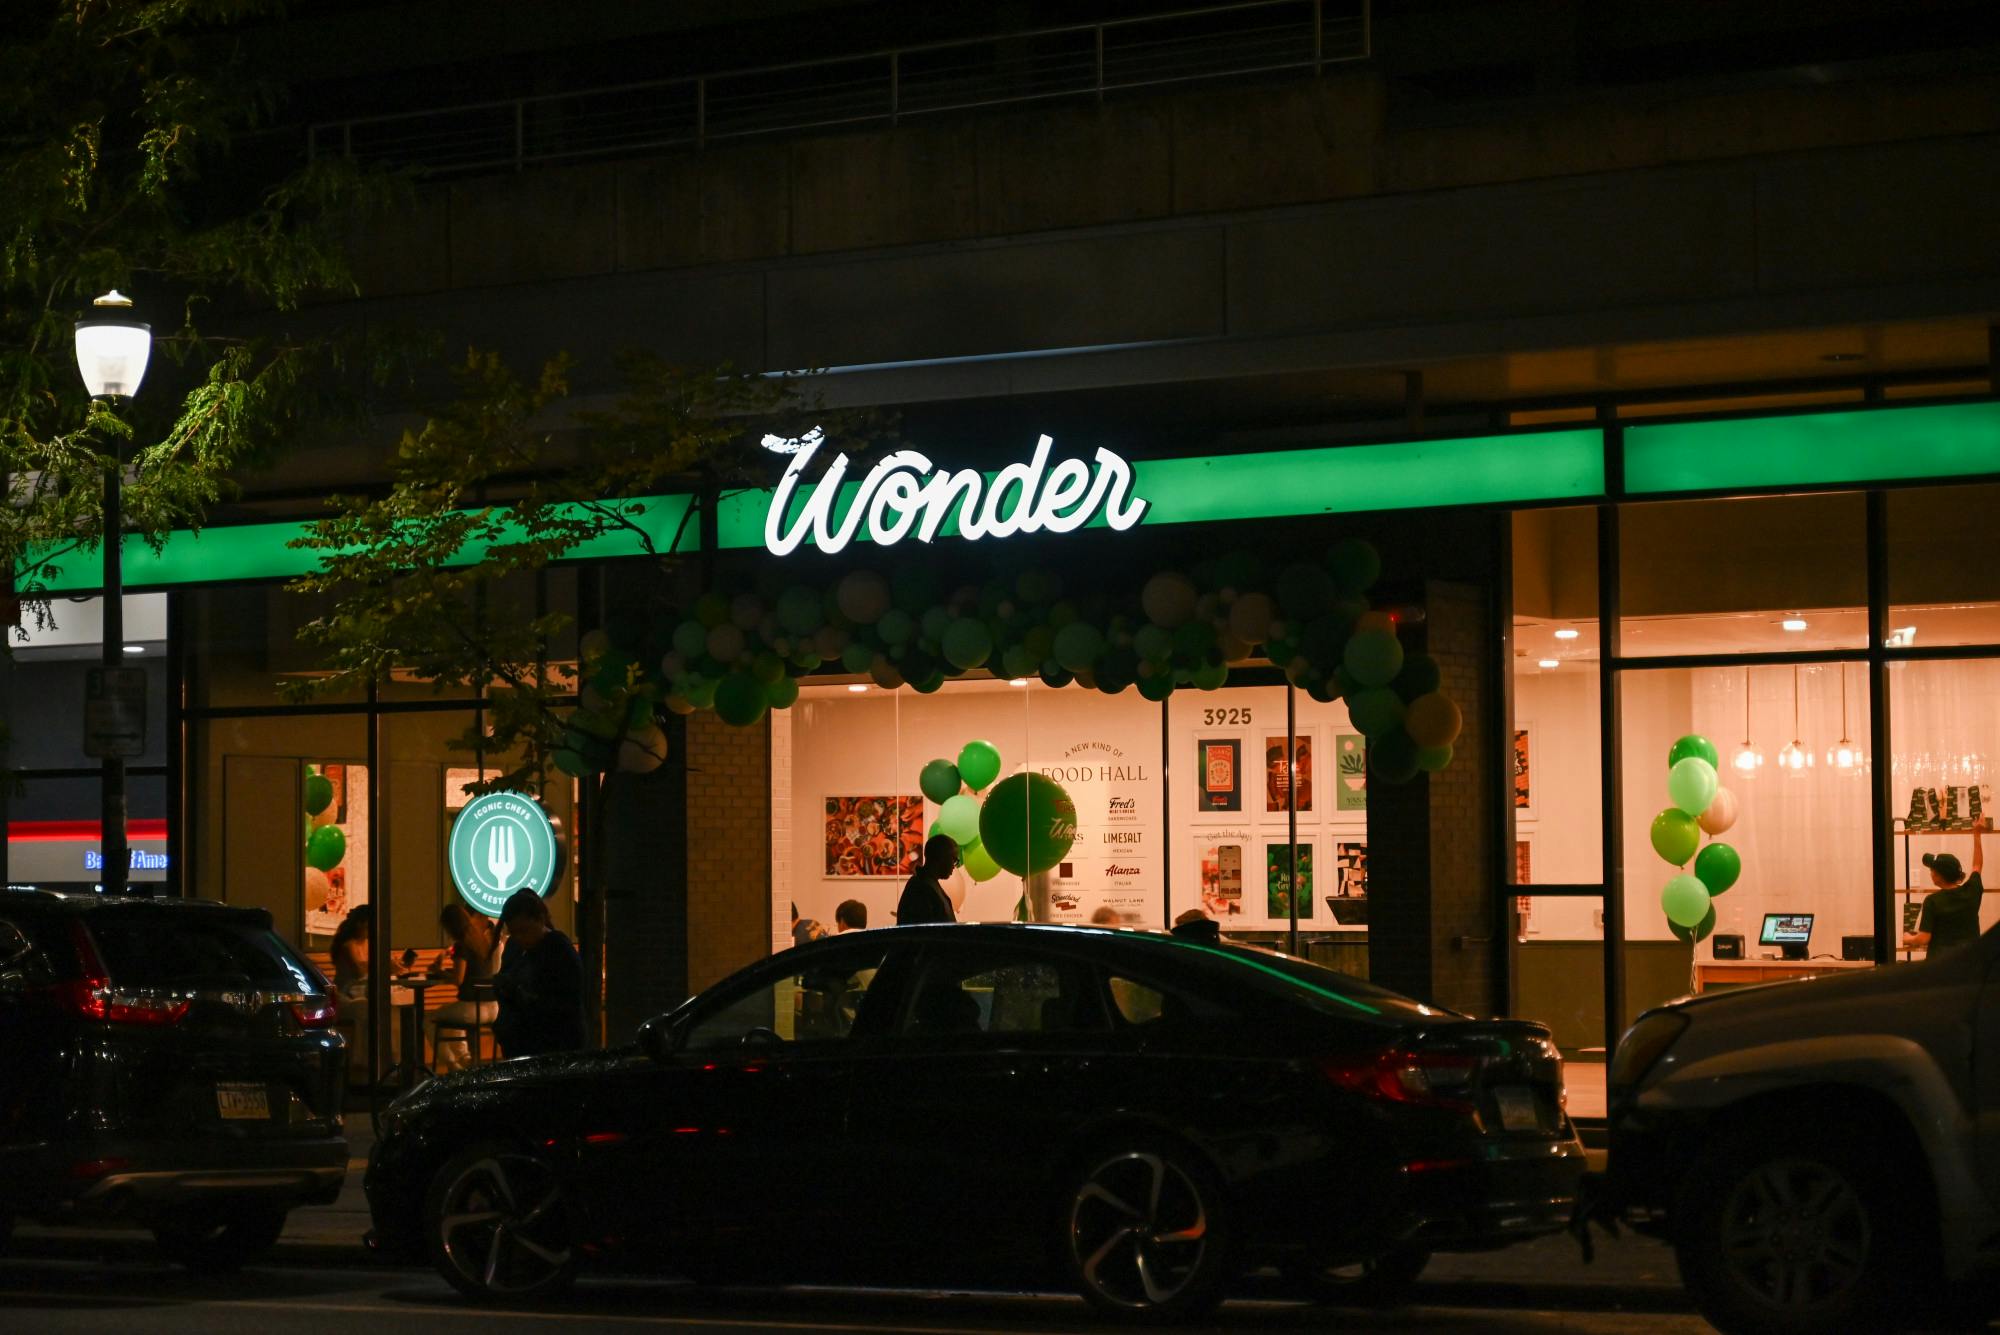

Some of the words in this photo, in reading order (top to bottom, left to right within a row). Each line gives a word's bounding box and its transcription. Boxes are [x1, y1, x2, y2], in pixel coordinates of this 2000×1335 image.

[760, 425, 1148, 556] Wonder
[1204, 708, 1252, 725] 3925
[1071, 743, 1089, 754] NEW
[1092, 742, 1112, 752] KIND
[1112, 748, 1124, 758] OF
[1041, 766, 1093, 783] FOOD
[1100, 765, 1148, 782] HALL
[473, 801, 503, 820] ICONIC
[505, 802, 531, 821] CHEFS
[1109, 797, 1135, 809] Fred's
[1103, 832, 1142, 844] LIMESALT
[1105, 864, 1141, 877] Alanza
[466, 878, 481, 895] TOP
